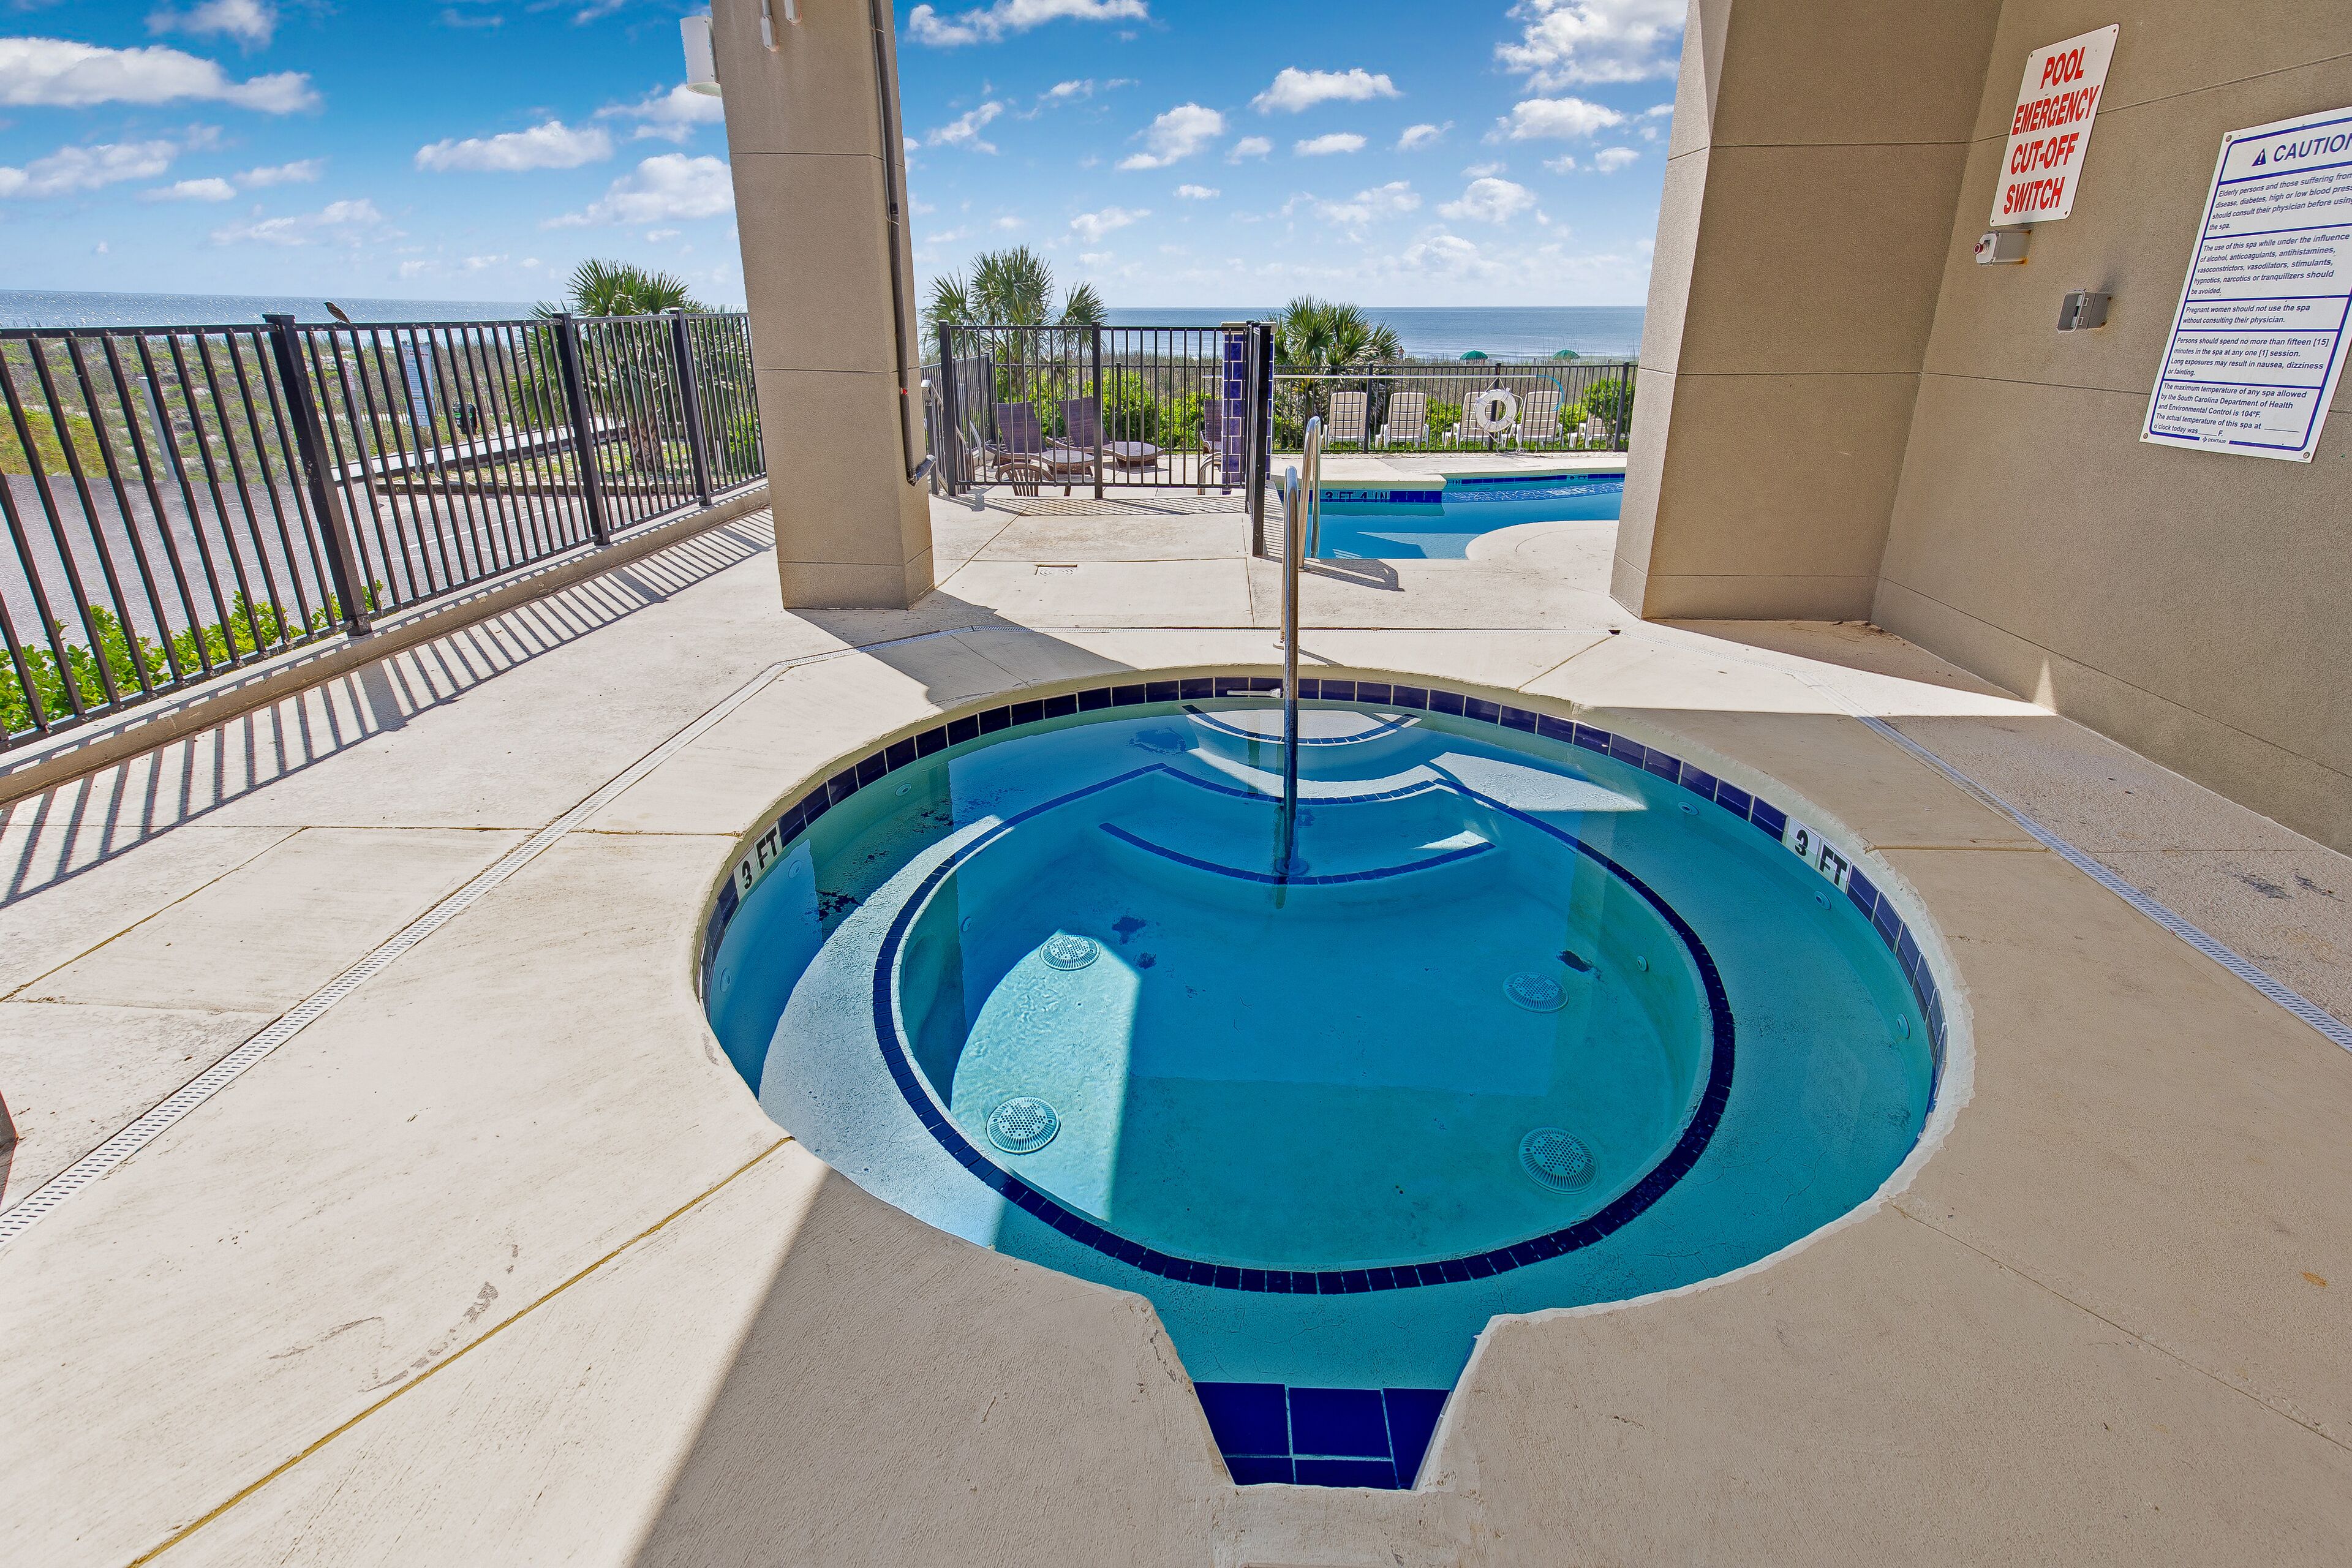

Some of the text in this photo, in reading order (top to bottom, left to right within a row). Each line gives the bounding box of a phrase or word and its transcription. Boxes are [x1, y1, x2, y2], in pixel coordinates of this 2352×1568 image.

[2040, 46, 2086, 89] POOL
[2011, 85, 2100, 135] EMERGENCY
[2011, 132, 2079, 175] CUT-OFF
[2239, 186, 2264, 195] persons
[2301, 175, 2334, 185] suffering
[2003, 176, 2065, 214] SWITCH
[2269, 193, 2284, 202] high
[2309, 186, 2331, 196] blood
[2332, 186, 2352, 194] pres
[2212, 211, 2232, 219] should
[2233, 208, 2255, 217] consult
[2272, 202, 2305, 213] physician
[2307, 199, 2331, 208] before
[2230, 251, 2277, 260] anticoagulants,
[2278, 247, 2335, 257] antihistamines,
[2261, 273, 2304, 281] tranquilizers
[2313, 338, 2329, 347] [15]
[2174, 368, 2195, 377] fainting.
[2168, 404, 2207, 413] Environmental
[2220, 398, 2258, 406] Department
[2182, 416, 2217, 425] temperature
[1325, 491, 1387, 500] 3 FT 4 IN
[742, 826, 777, 889] 3 FT
[1795, 829, 1848, 886] 3 FT
